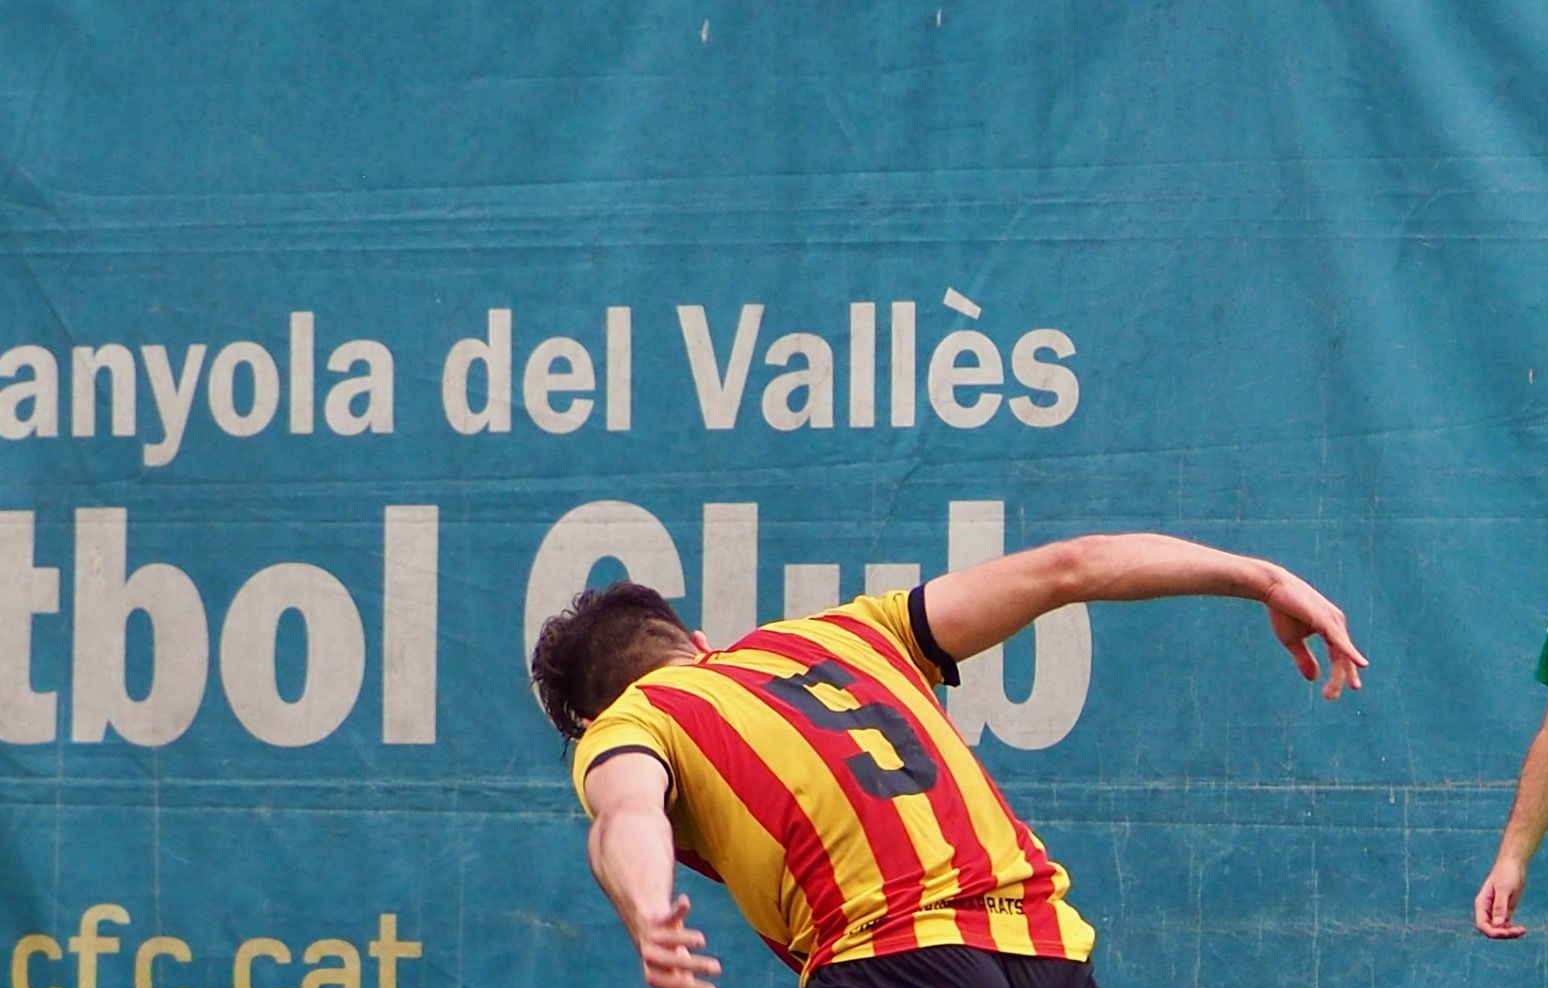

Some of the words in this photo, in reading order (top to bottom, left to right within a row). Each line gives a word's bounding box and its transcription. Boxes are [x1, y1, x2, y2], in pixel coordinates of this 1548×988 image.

[0, 311, 395, 467] anyola
[442, 306, 631, 435] del
[677, 287, 1080, 431] Vallès
[0, 504, 439, 748] tbol
[762, 659, 938, 800] 5
